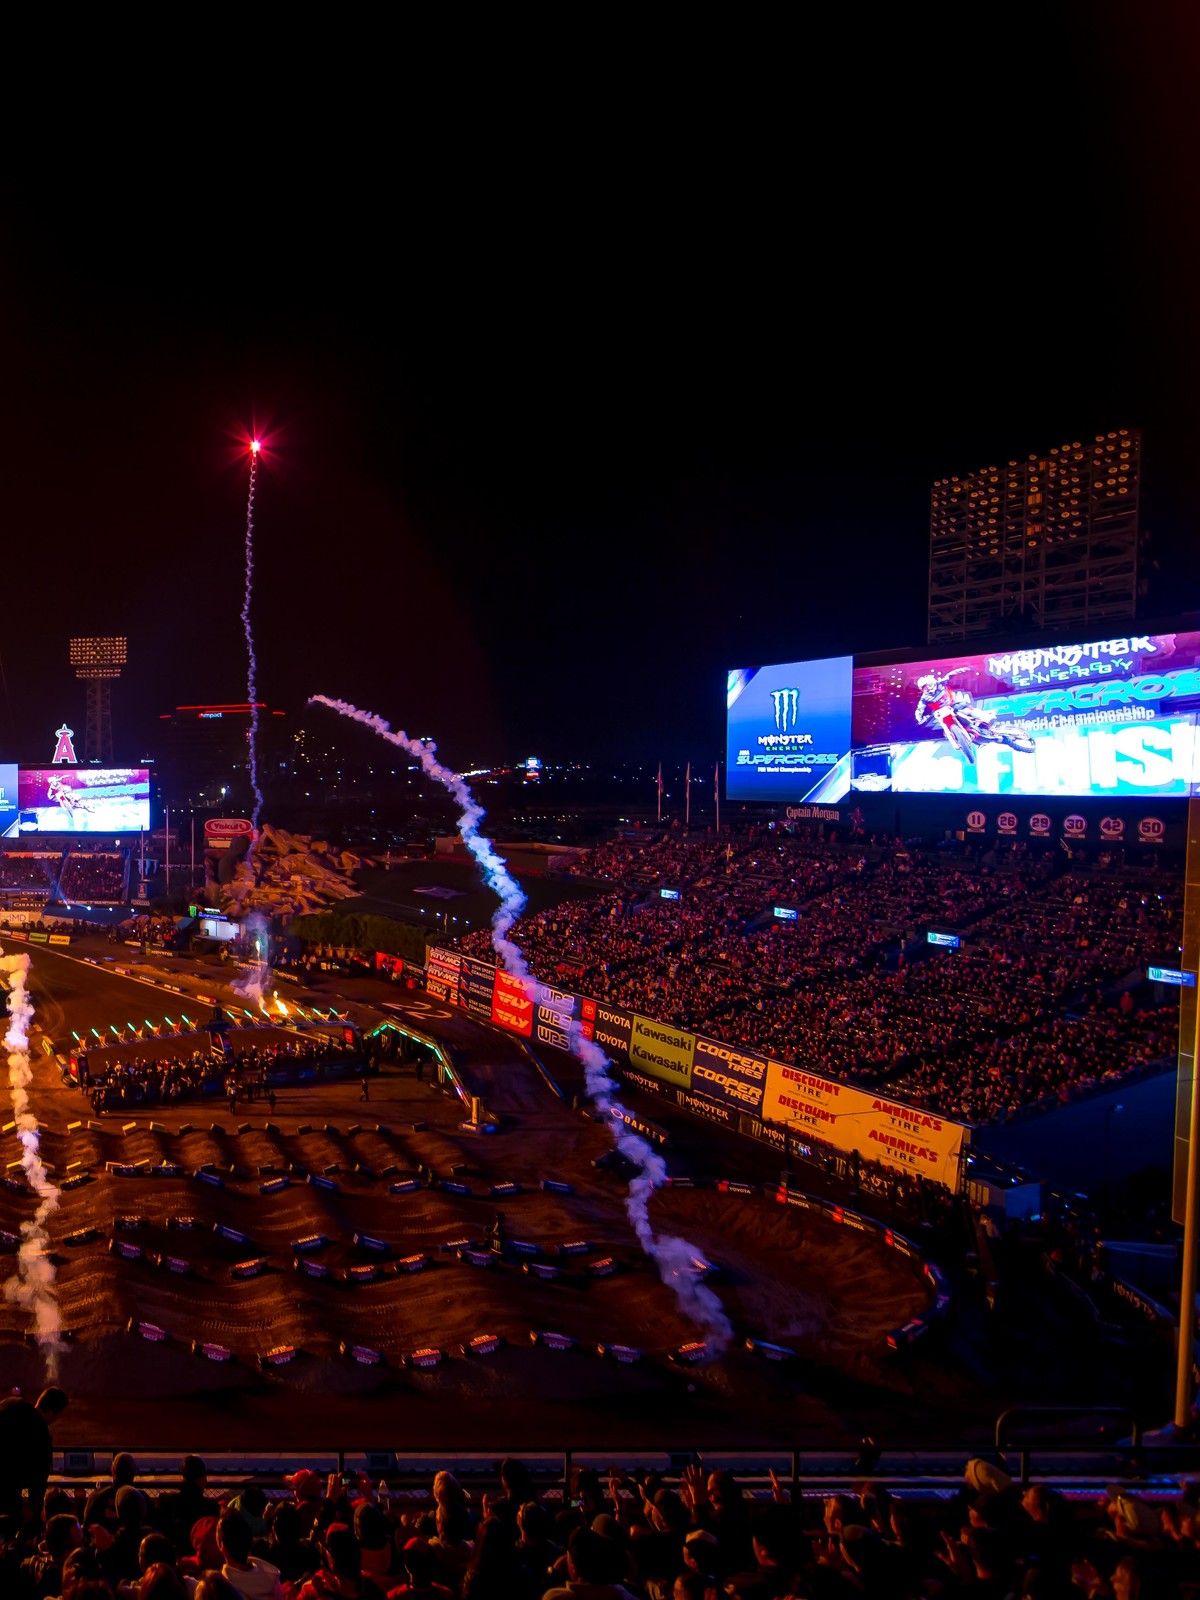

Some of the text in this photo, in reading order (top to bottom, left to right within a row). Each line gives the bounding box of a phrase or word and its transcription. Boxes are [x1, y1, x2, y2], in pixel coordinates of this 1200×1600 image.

[757, 734, 813, 746] MONSTER
[786, 806, 840, 821] Captain Morgan
[971, 815, 981, 825] 11
[1000, 816, 1015, 826] 26
[1066, 819, 1084, 830] 30
[1101, 820, 1121, 832] 42
[1141, 822, 1161, 834] 50
[498, 972, 535, 991] FLY
[496, 990, 531, 1010] FLY
[540, 986, 575, 1011] WPS
[495, 1008, 529, 1029] FLY
[538, 1005, 573, 1031] WPS
[598, 1009, 631, 1030] TOYOTA
[537, 1024, 571, 1051] WPS
[595, 1030, 628, 1051] TOYOTA
[635, 1022, 692, 1052] Kawasaki
[632, 1044, 689, 1076] Kawasaki
[696, 1041, 766, 1072] COOPER
[727, 1061, 765, 1080] TIRES
[693, 1065, 763, 1099] COOPER
[781, 1067, 841, 1097] DISCOUNT
[796, 1083, 823, 1099] TIRE
[724, 1085, 761, 1106] TIRES
[686, 1095, 730, 1121] MONSTER
[778, 1094, 837, 1125] DISCOUNT
[792, 1110, 818, 1126] TIRE
[872, 1100, 943, 1132] AMERICA'S
[623, 1116, 667, 1145] OAKLEY
[890, 1117, 921, 1134] TIRE
[763, 1126, 811, 1153] MONTER
[868, 1130, 939, 1163] AMERICA'S
[886, 1147, 916, 1164] TIRE
[729, 1186, 752, 1195] TOYOTA
[787, 1198, 810, 1210] TOYOTA
[842, 1218, 865, 1232] TOYOTA
